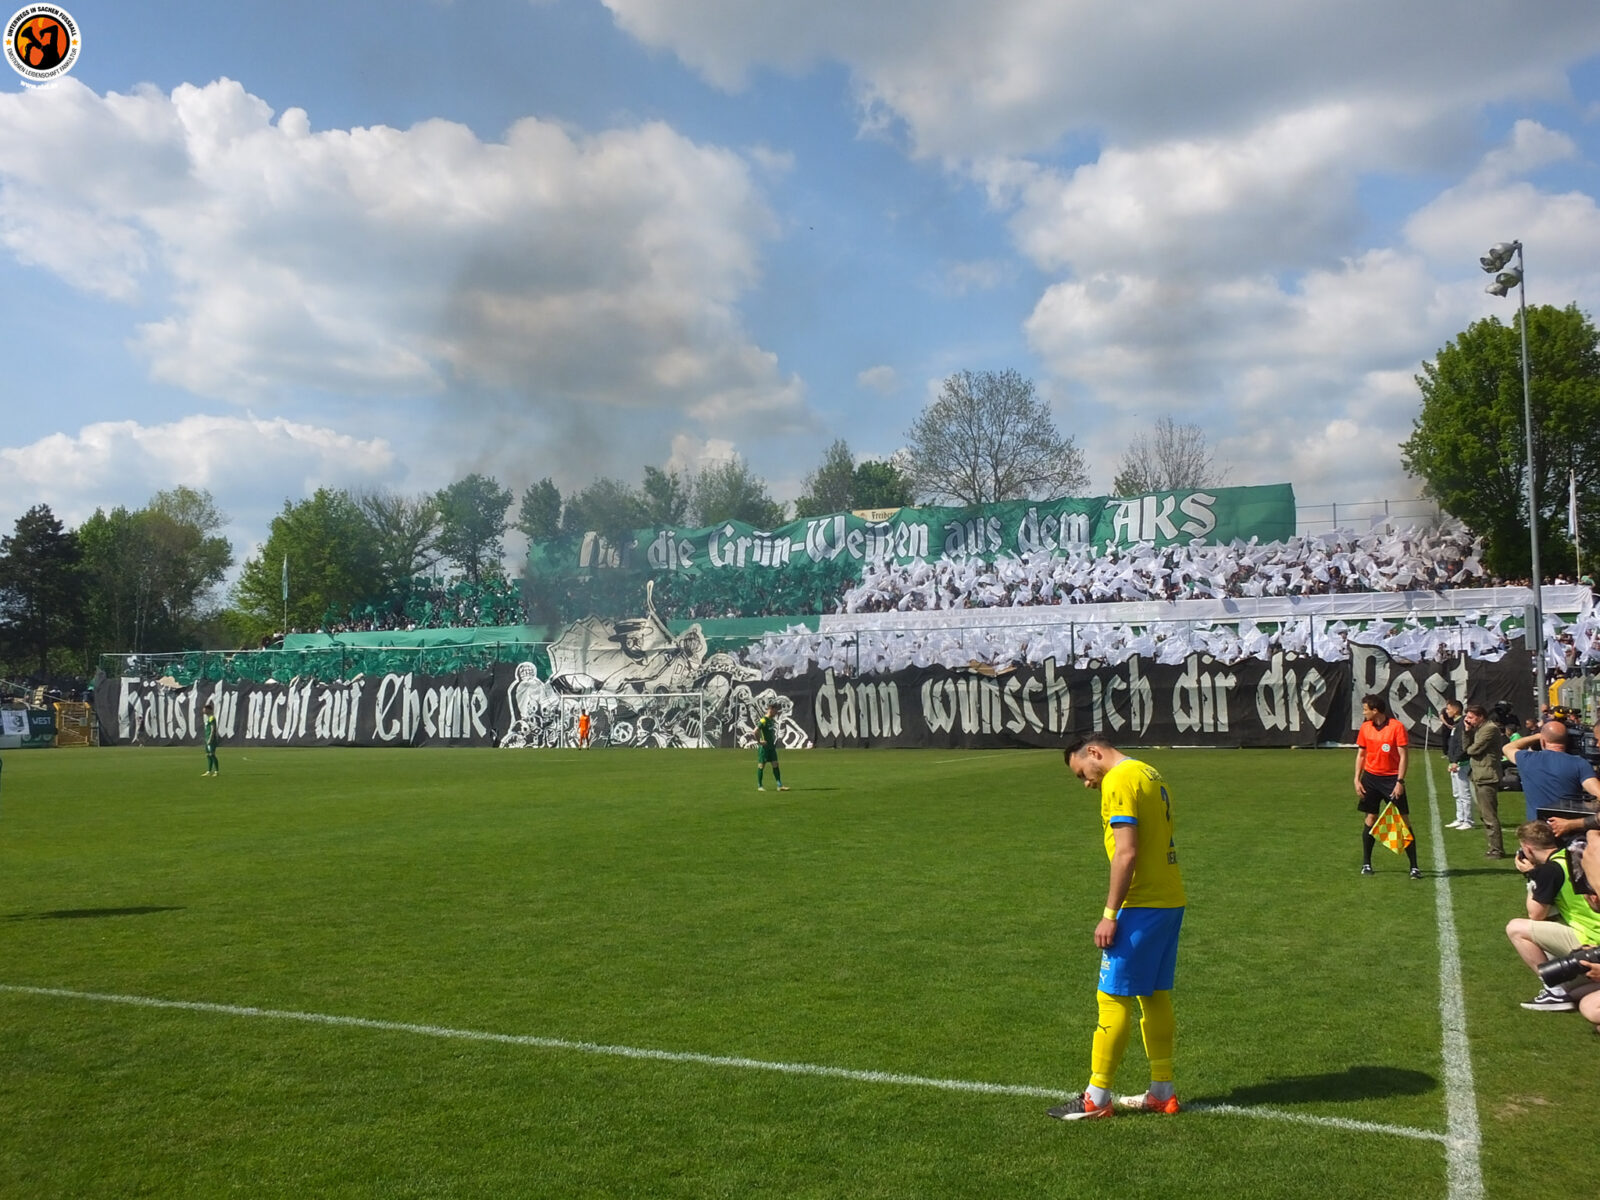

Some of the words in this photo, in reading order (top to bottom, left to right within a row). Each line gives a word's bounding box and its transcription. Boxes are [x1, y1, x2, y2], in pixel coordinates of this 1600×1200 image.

[647, 530, 696, 570] die
[944, 516, 1002, 558] aus
[1017, 507, 1090, 553] dem
[1105, 492, 1217, 545] AKS
[203, 679, 239, 739] du
[245, 675, 314, 743] nicht
[314, 676, 366, 742] auf
[371, 671, 488, 744] Chemie
[814, 667, 903, 739] dann
[1091, 654, 1154, 738] ich
[1172, 653, 1237, 733] dir
[1255, 651, 1327, 730] die
[1350, 643, 1469, 733] Pest
